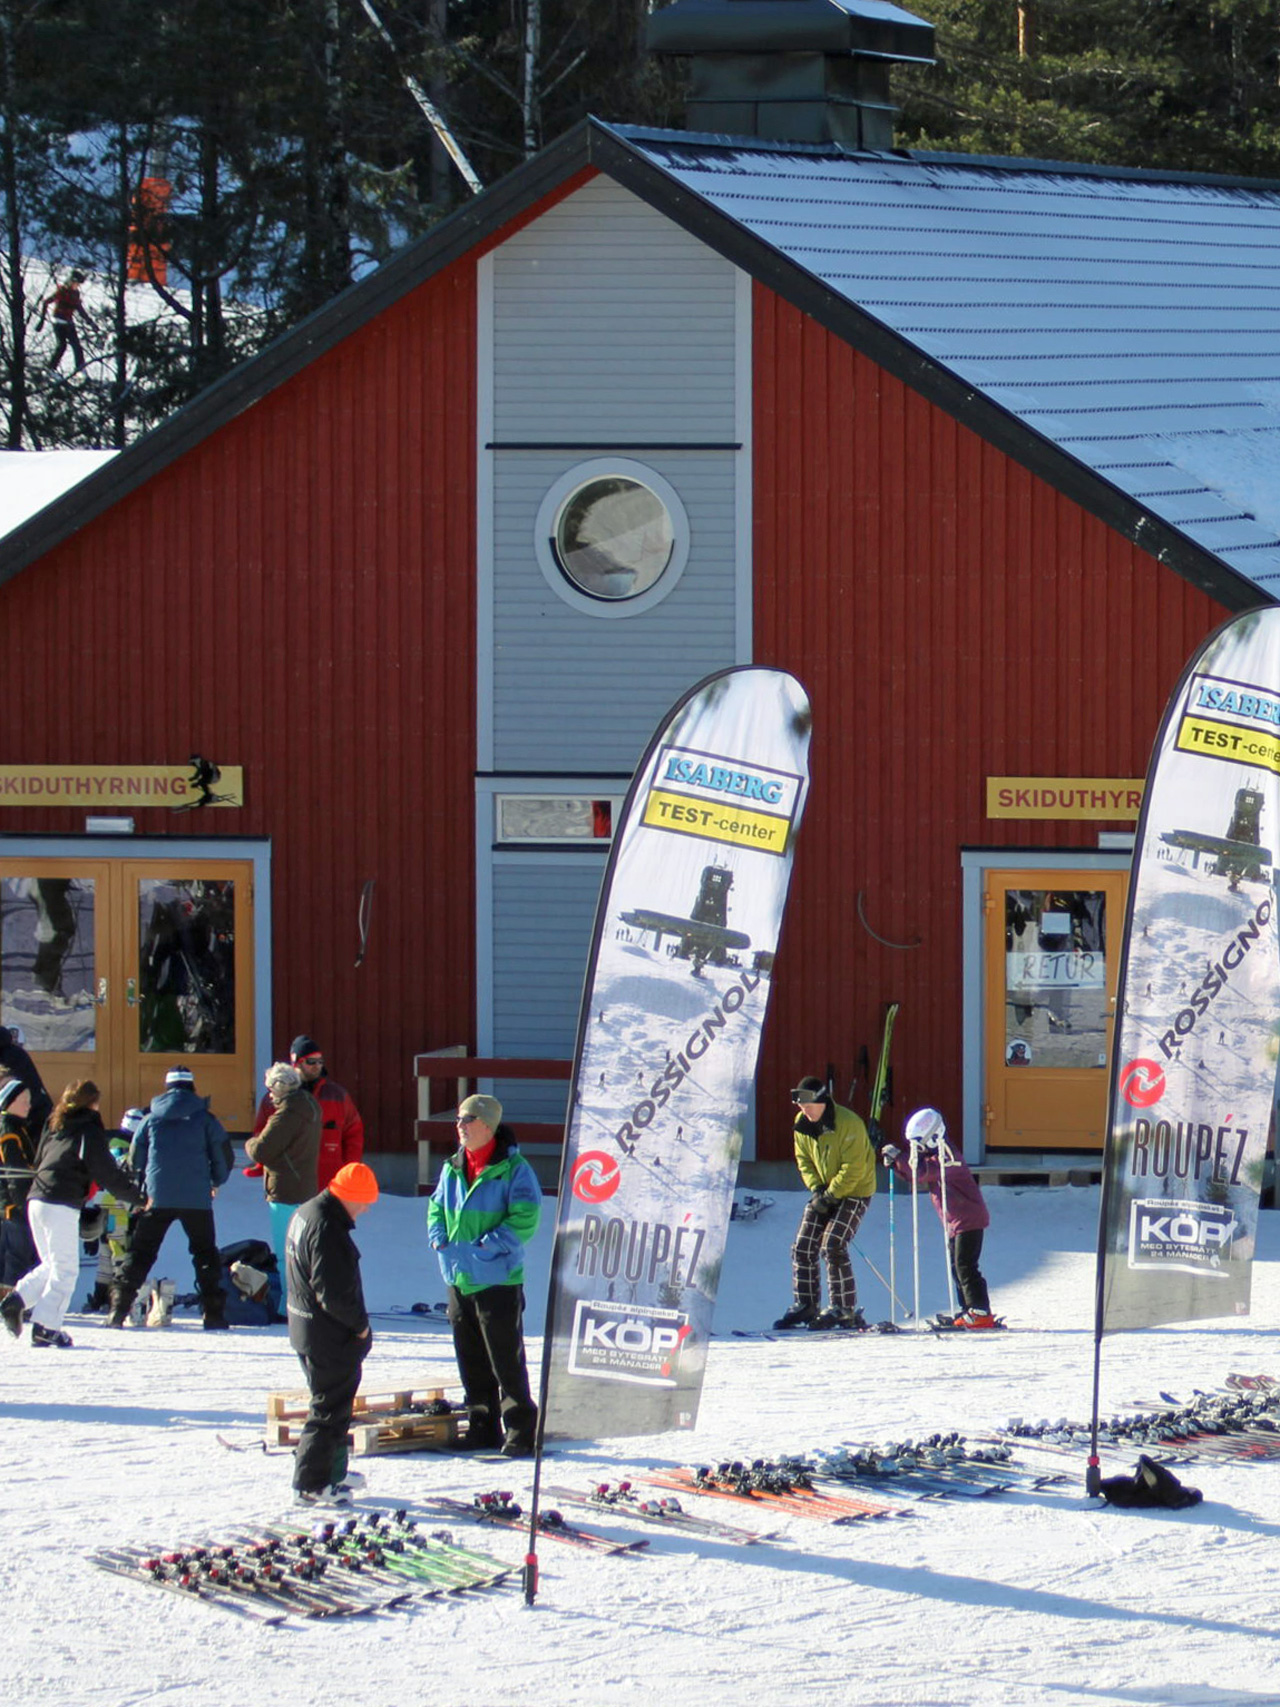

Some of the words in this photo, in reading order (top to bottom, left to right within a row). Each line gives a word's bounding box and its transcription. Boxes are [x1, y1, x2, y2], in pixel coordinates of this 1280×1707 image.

[0, 776, 187, 795] KIDUTHYRNING
[664, 757, 783, 804] ISABERG
[998, 789, 1142, 809] SKIDUTHYR
[658, 802, 777, 840] TEST-center
[1022, 953, 1097, 980] RETUR
[1159, 888, 1275, 1059] ROSSIGNO
[615, 971, 761, 1154] ROSSIGNOL
[1131, 1114, 1248, 1186] ROUPÉZ
[577, 1213, 706, 1289] ROUPÉZ
